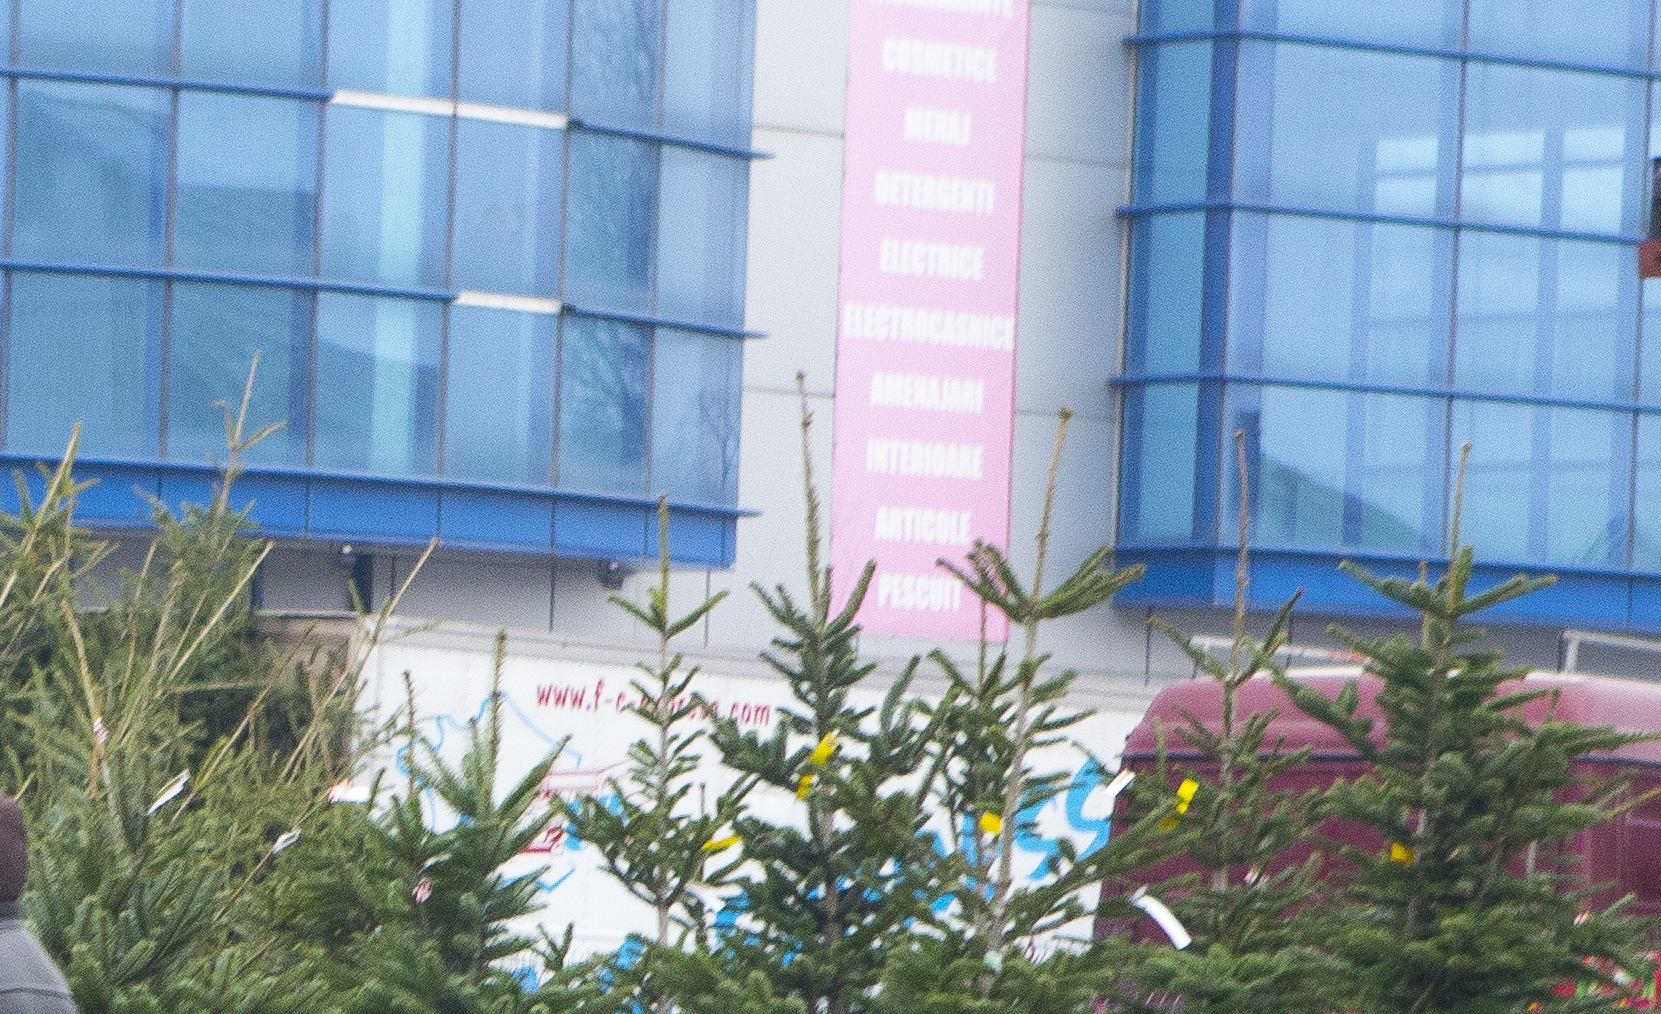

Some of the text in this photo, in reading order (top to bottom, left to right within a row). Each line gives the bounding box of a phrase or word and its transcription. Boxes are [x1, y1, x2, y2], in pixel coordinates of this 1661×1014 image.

[882, 36, 997, 83] COSMETICE
[904, 107, 971, 146] MENAJ
[875, 170, 996, 216] DETERGENTI
[879, 238, 985, 281] ELECTRICE
[870, 371, 985, 414] AMENAJARI
[866, 437, 984, 481] INTERIOARE
[874, 506, 972, 547] ARTICOLE
[877, 573, 963, 612] PESCUIT
